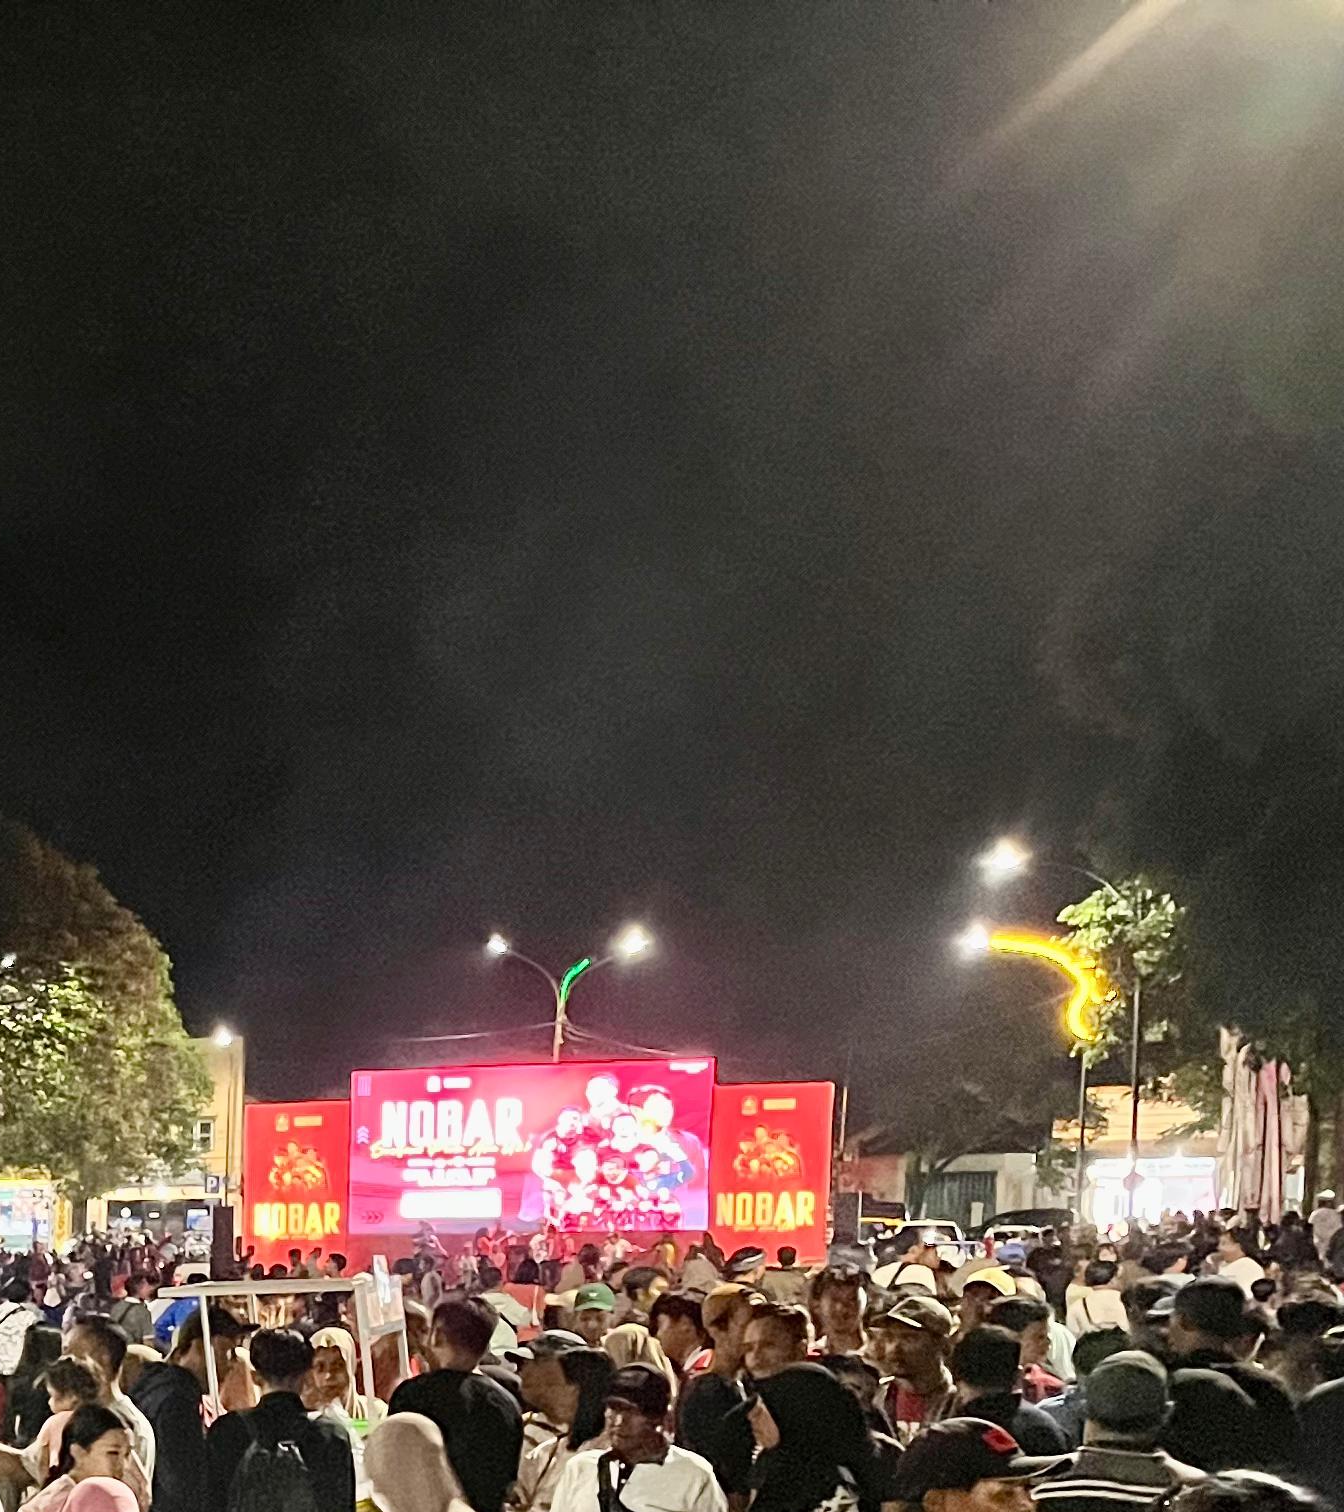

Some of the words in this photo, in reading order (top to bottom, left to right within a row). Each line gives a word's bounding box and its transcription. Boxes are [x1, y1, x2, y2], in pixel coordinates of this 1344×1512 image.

[381, 1097, 523, 1149] NOBAR
[254, 1202, 340, 1237] NOBAR
[716, 1191, 815, 1227] NOBAR
